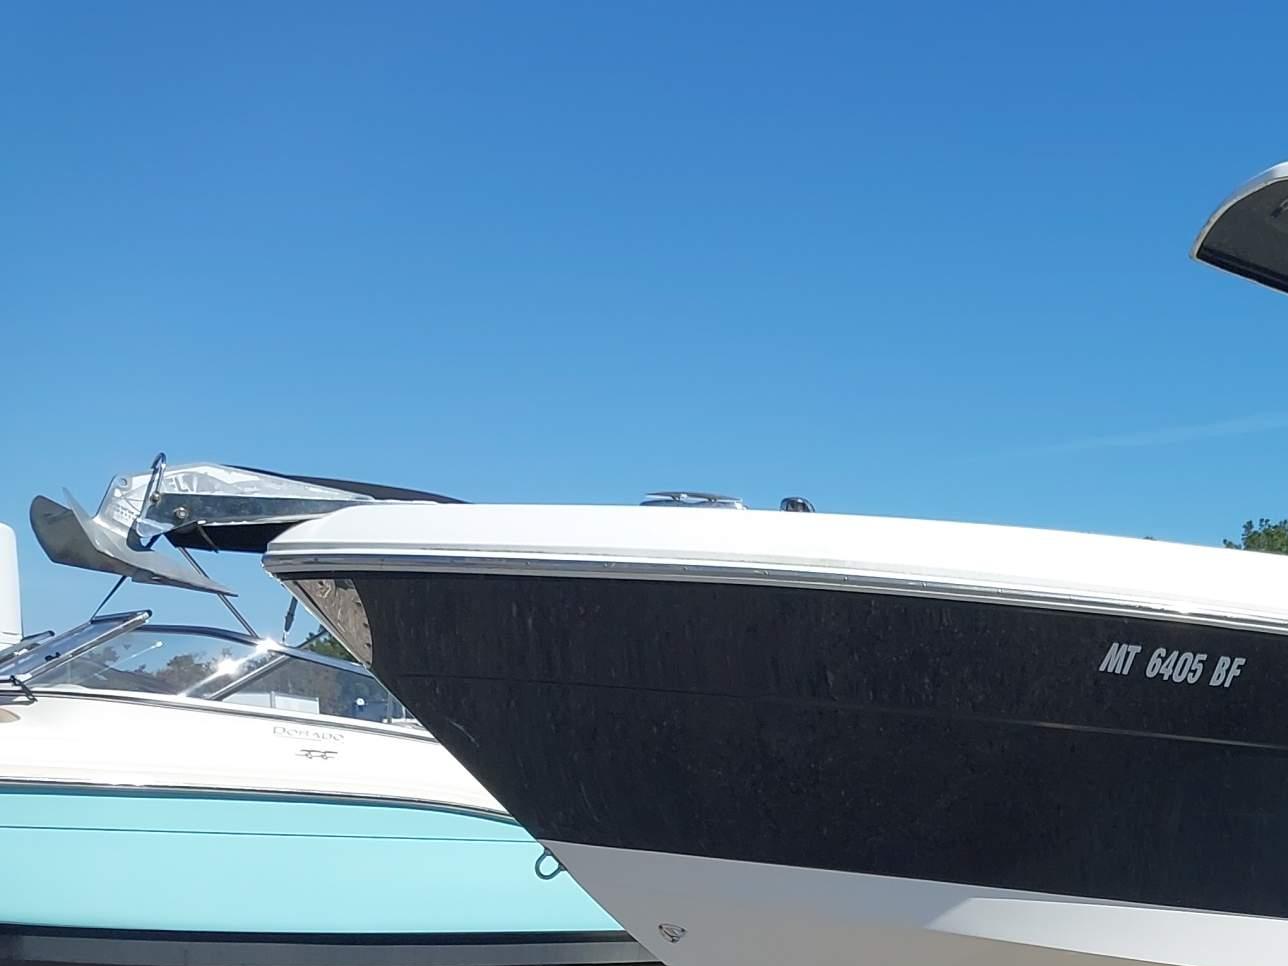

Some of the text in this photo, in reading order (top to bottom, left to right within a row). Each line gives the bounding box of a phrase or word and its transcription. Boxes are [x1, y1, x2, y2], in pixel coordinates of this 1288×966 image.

[1099, 642, 1246, 688] MT 6405 BF
